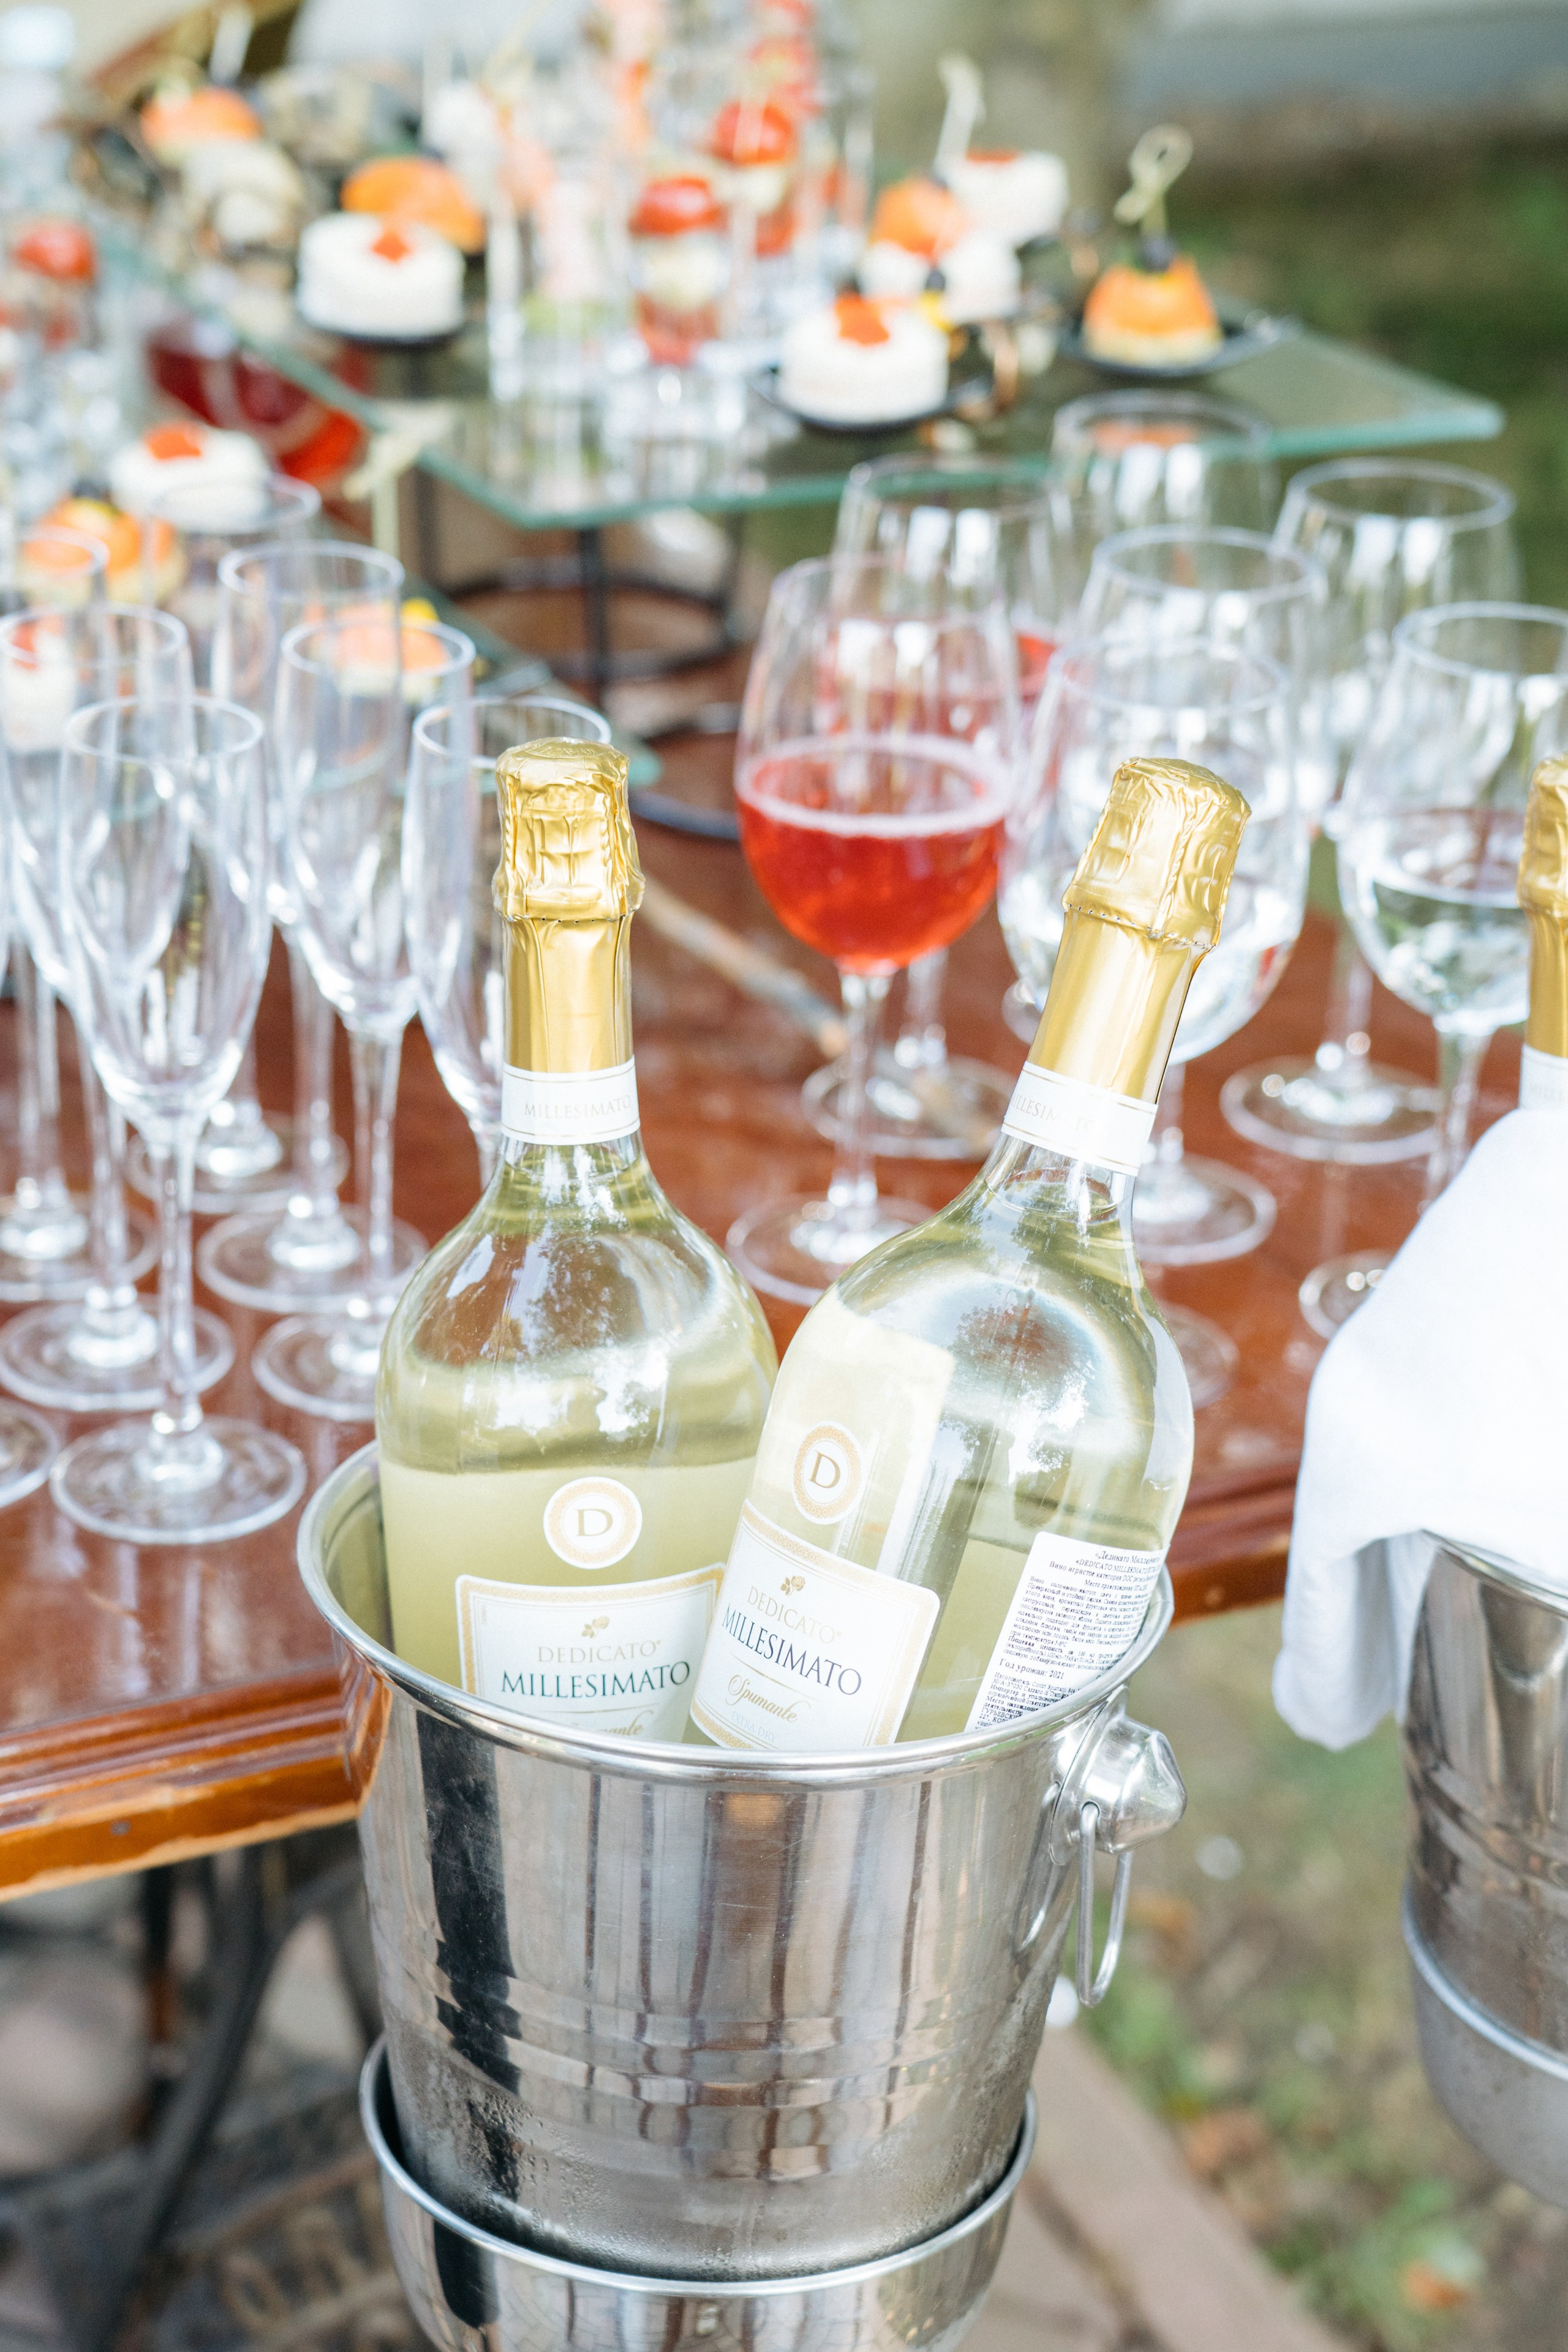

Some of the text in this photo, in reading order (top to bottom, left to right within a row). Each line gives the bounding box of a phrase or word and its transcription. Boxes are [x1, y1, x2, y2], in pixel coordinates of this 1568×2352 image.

[524, 1095, 631, 1120] MILLESIMATO
[808, 1450, 842, 1489] D
[573, 1508, 613, 1537] D
[1049, 1561, 1068, 1570] Вино
[1067, 1566, 1095, 1578] игристое
[747, 1585, 838, 1645] DEDICATO
[538, 1640, 658, 1664] DEDICATO
[722, 1603, 862, 1695] MILLESIMATO
[501, 1660, 690, 1698] MILLESIMATO
[998, 1658, 1065, 1679] Год урожая: 2021
[725, 1674, 812, 1723] Spumante
[731, 1711, 777, 1744] EXTRA DRY
